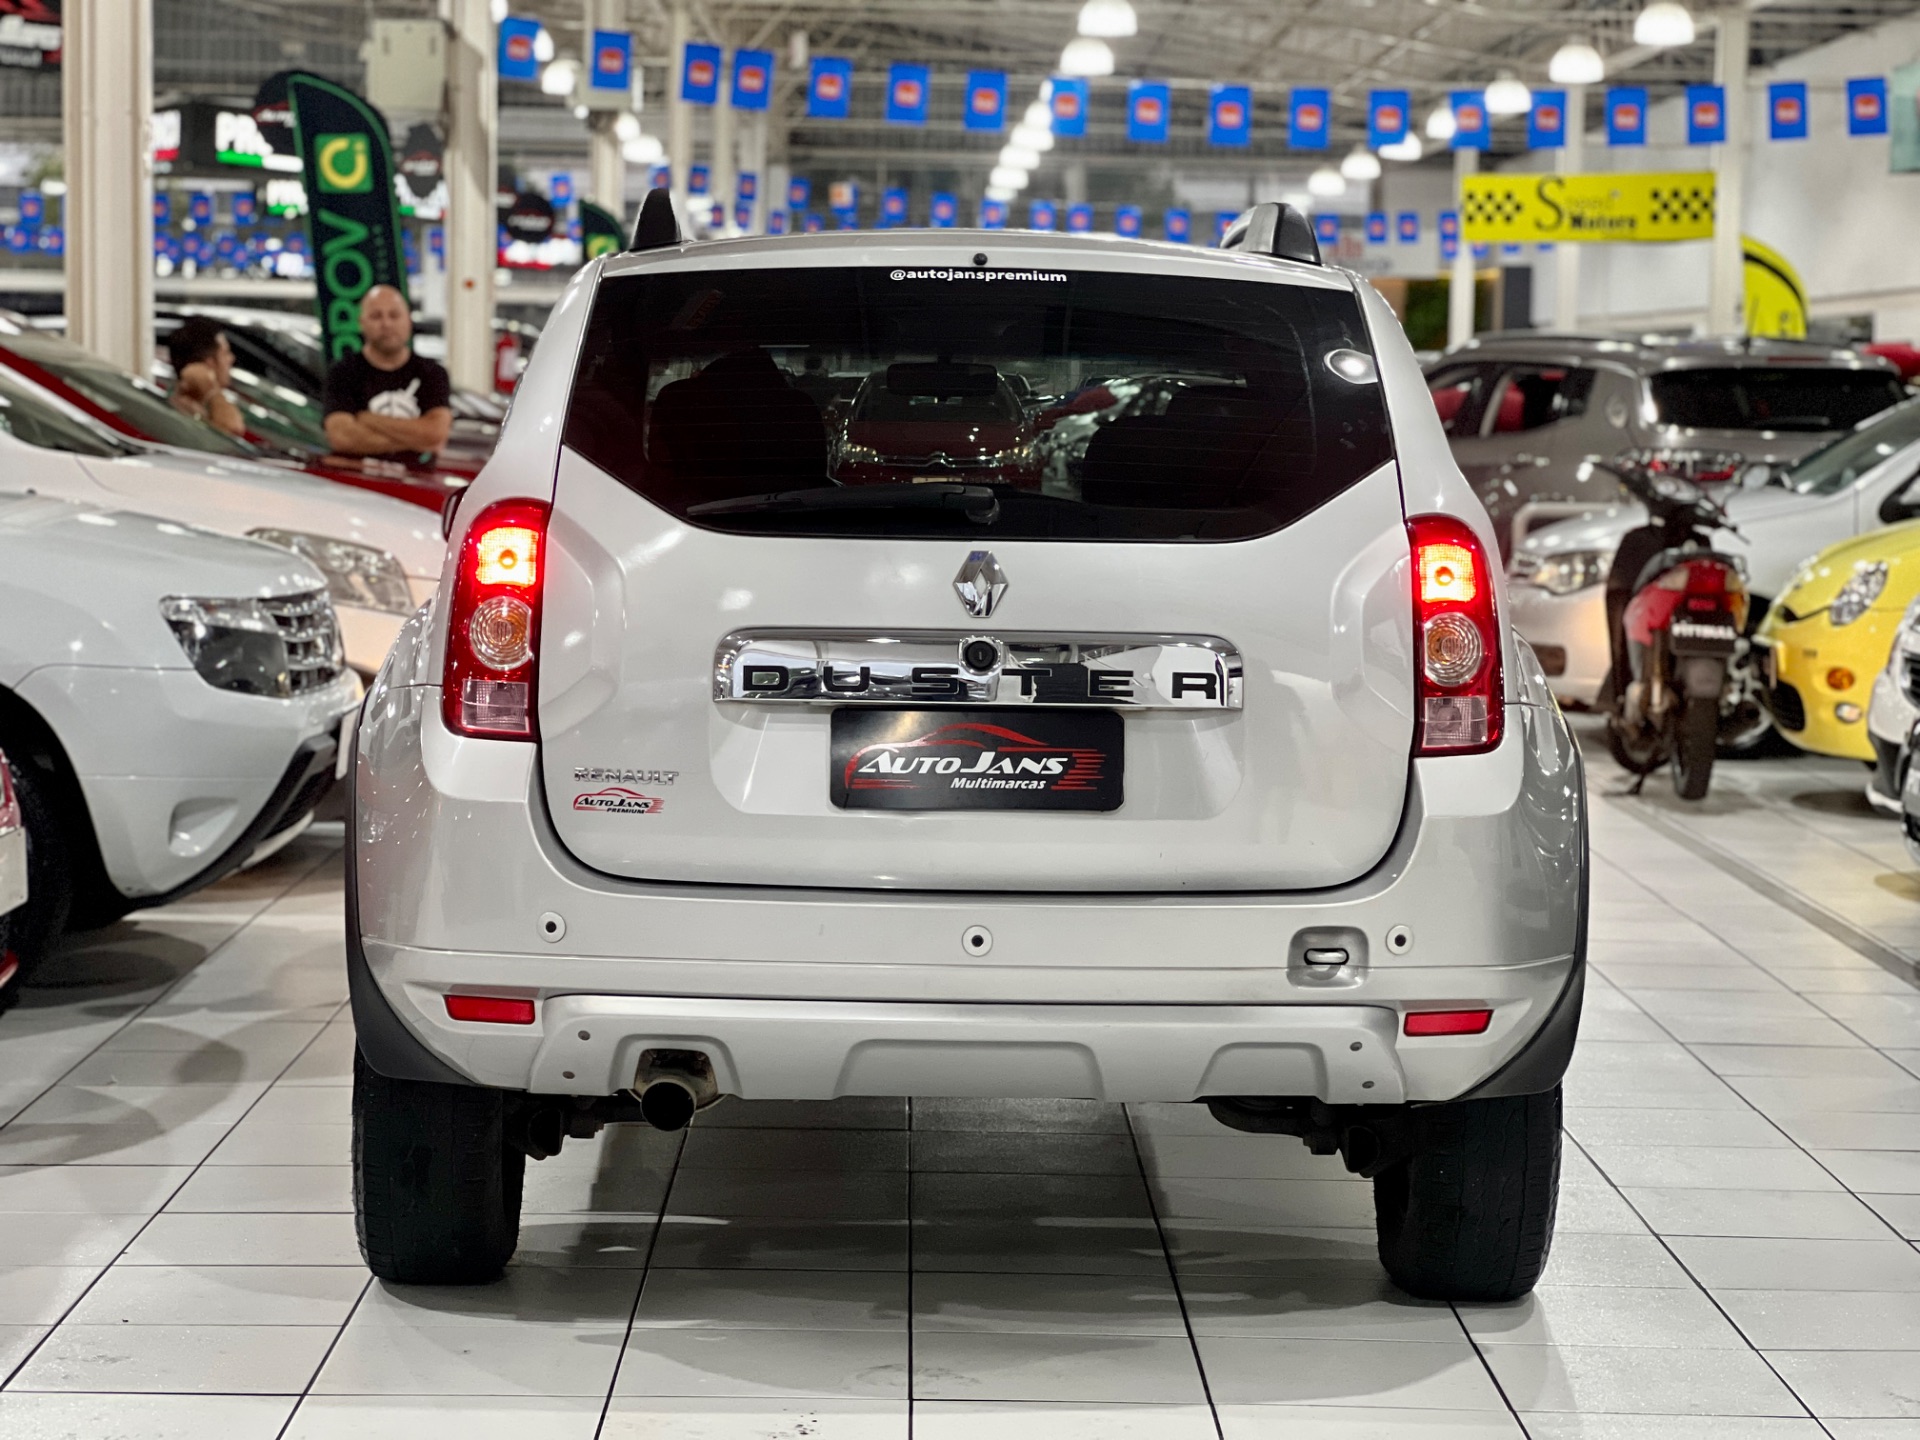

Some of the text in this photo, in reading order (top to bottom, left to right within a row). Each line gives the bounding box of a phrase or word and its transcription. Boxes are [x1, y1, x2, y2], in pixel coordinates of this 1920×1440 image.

[889, 269, 1068, 282] @autojanspremium
[742, 664, 1218, 701] DUSTER
[574, 766, 680, 786] RENAULT
[950, 777, 1047, 790] Multimarcas
[606, 807, 645, 815] PREMIUM
